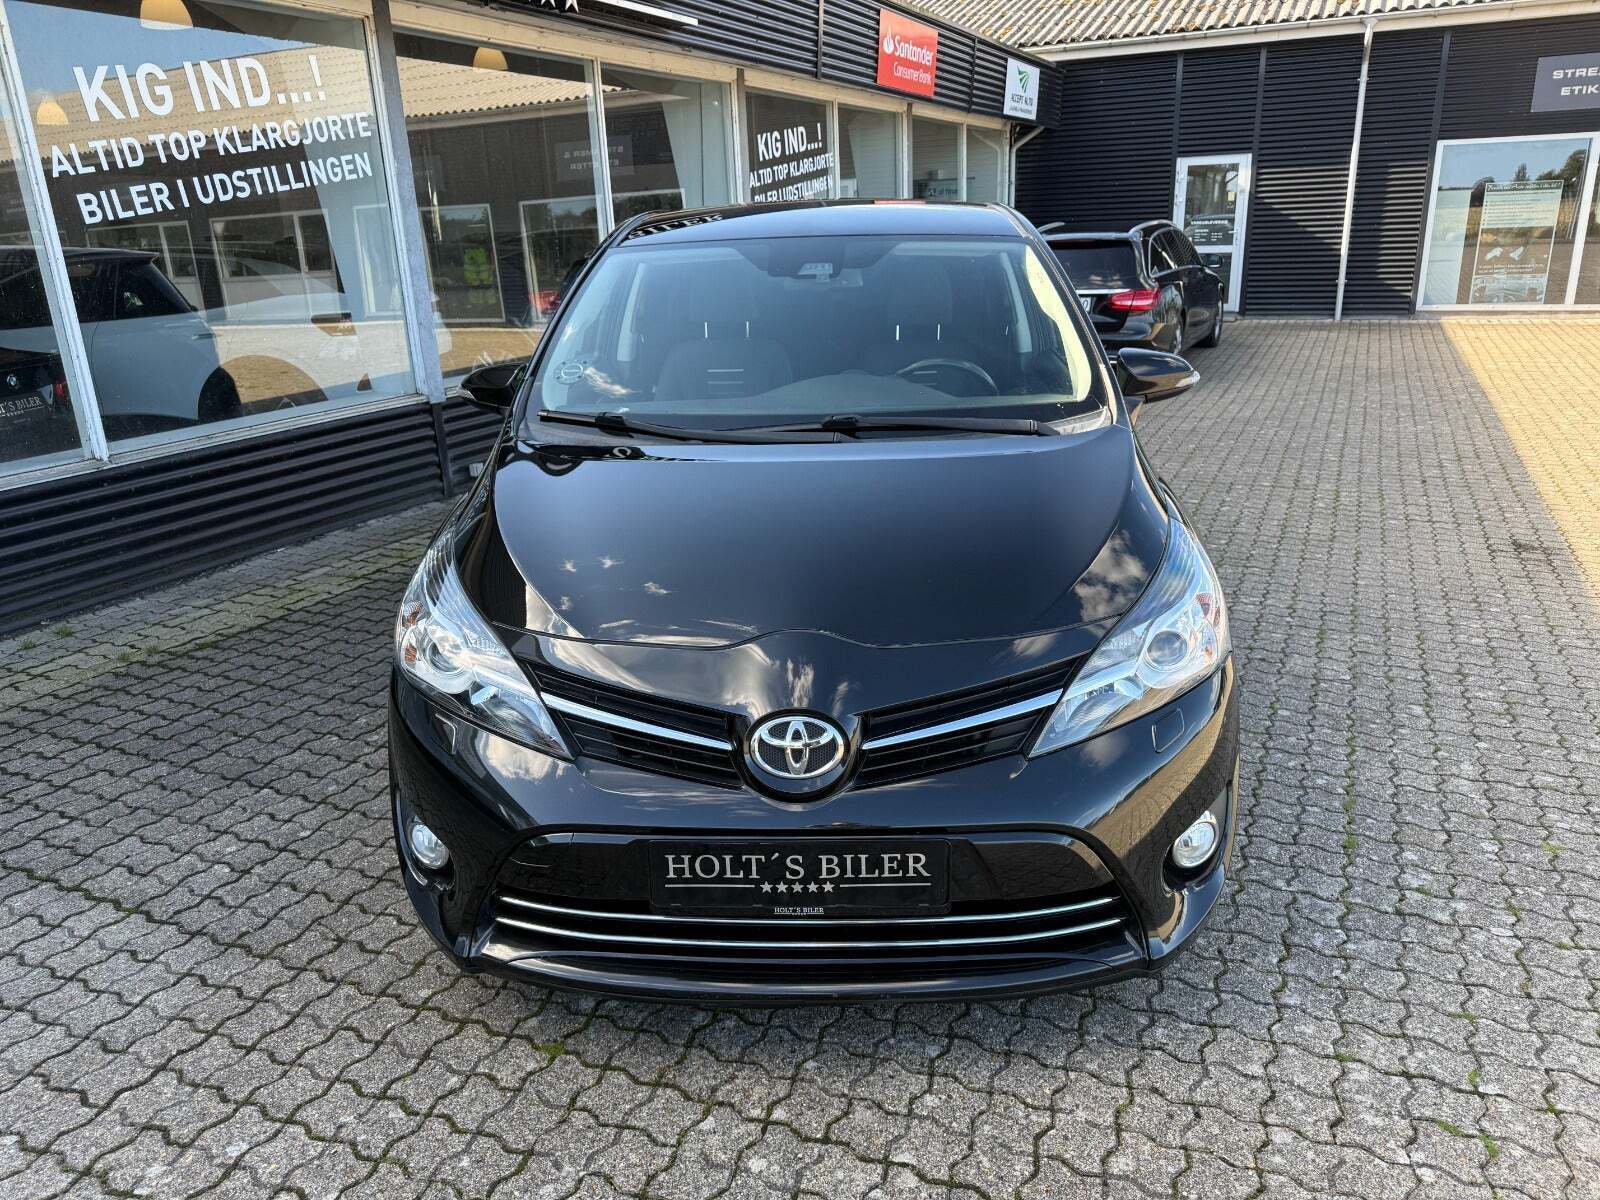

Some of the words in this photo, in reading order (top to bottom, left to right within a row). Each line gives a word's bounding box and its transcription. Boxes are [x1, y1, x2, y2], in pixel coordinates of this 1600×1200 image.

[894, 35, 934, 66] Santander
[72, 62, 174, 122] KIG
[182, 54, 326, 113] IND...!
[1552, 66, 1600, 79] STRE
[51, 136, 145, 178] ALTID
[147, 129, 207, 164] TOP
[212, 111, 372, 156] KLARGJORTE
[757, 130, 782, 162] KIG
[783, 122, 822, 156] IND...!
[749, 167, 773, 189] ALTID
[773, 163, 789, 182] TOP
[789, 151, 834, 178] KLARGJORTE
[76, 181, 175, 225] BILER
[176, 178, 190, 208] I
[192, 151, 373, 205] UDSTILLINGEN
[783, 174, 833, 201] UDSTILLINGEN
[15, 396, 43, 410] BILER
[818, 853, 932, 879] BILER
